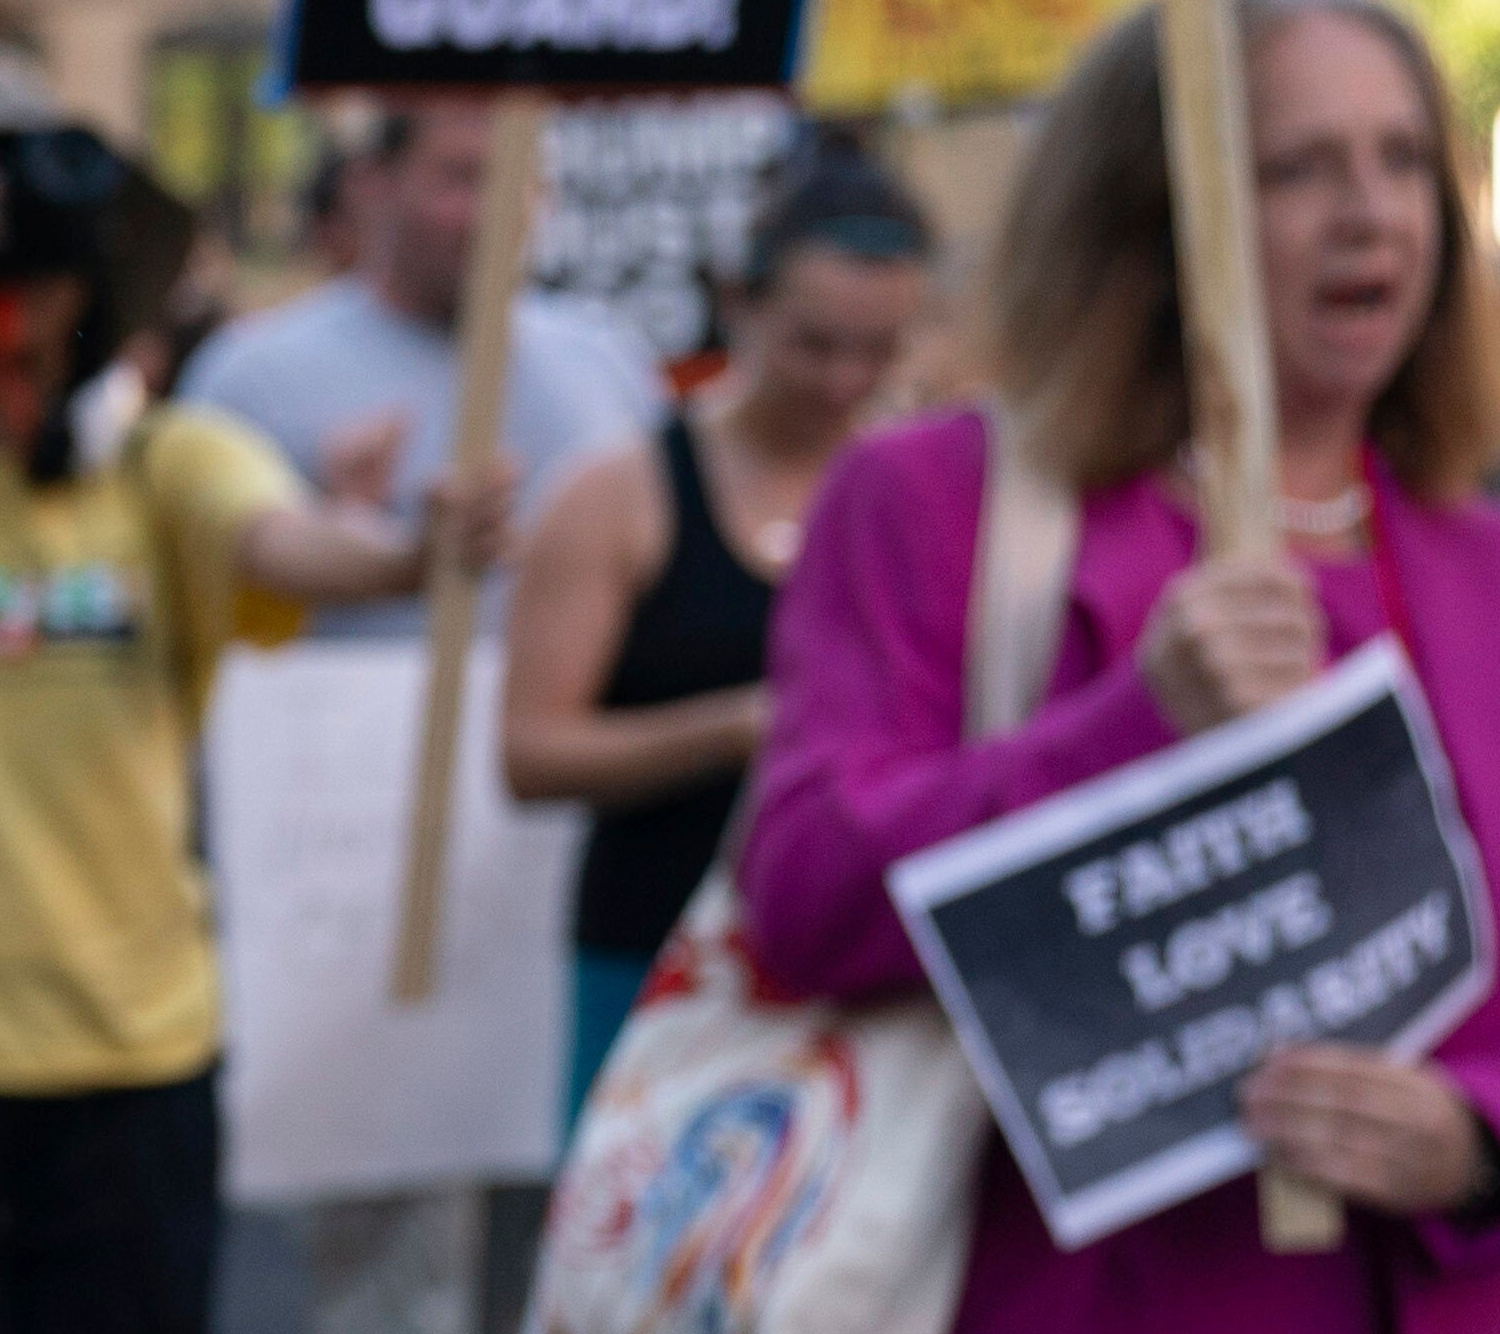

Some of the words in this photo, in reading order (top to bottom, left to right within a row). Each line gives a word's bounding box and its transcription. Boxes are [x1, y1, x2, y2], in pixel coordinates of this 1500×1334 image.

[1061, 774, 1314, 937] FAITH
[1038, 889, 1454, 1146] SOLIDARITY
[1119, 870, 1333, 1012] LOVE
